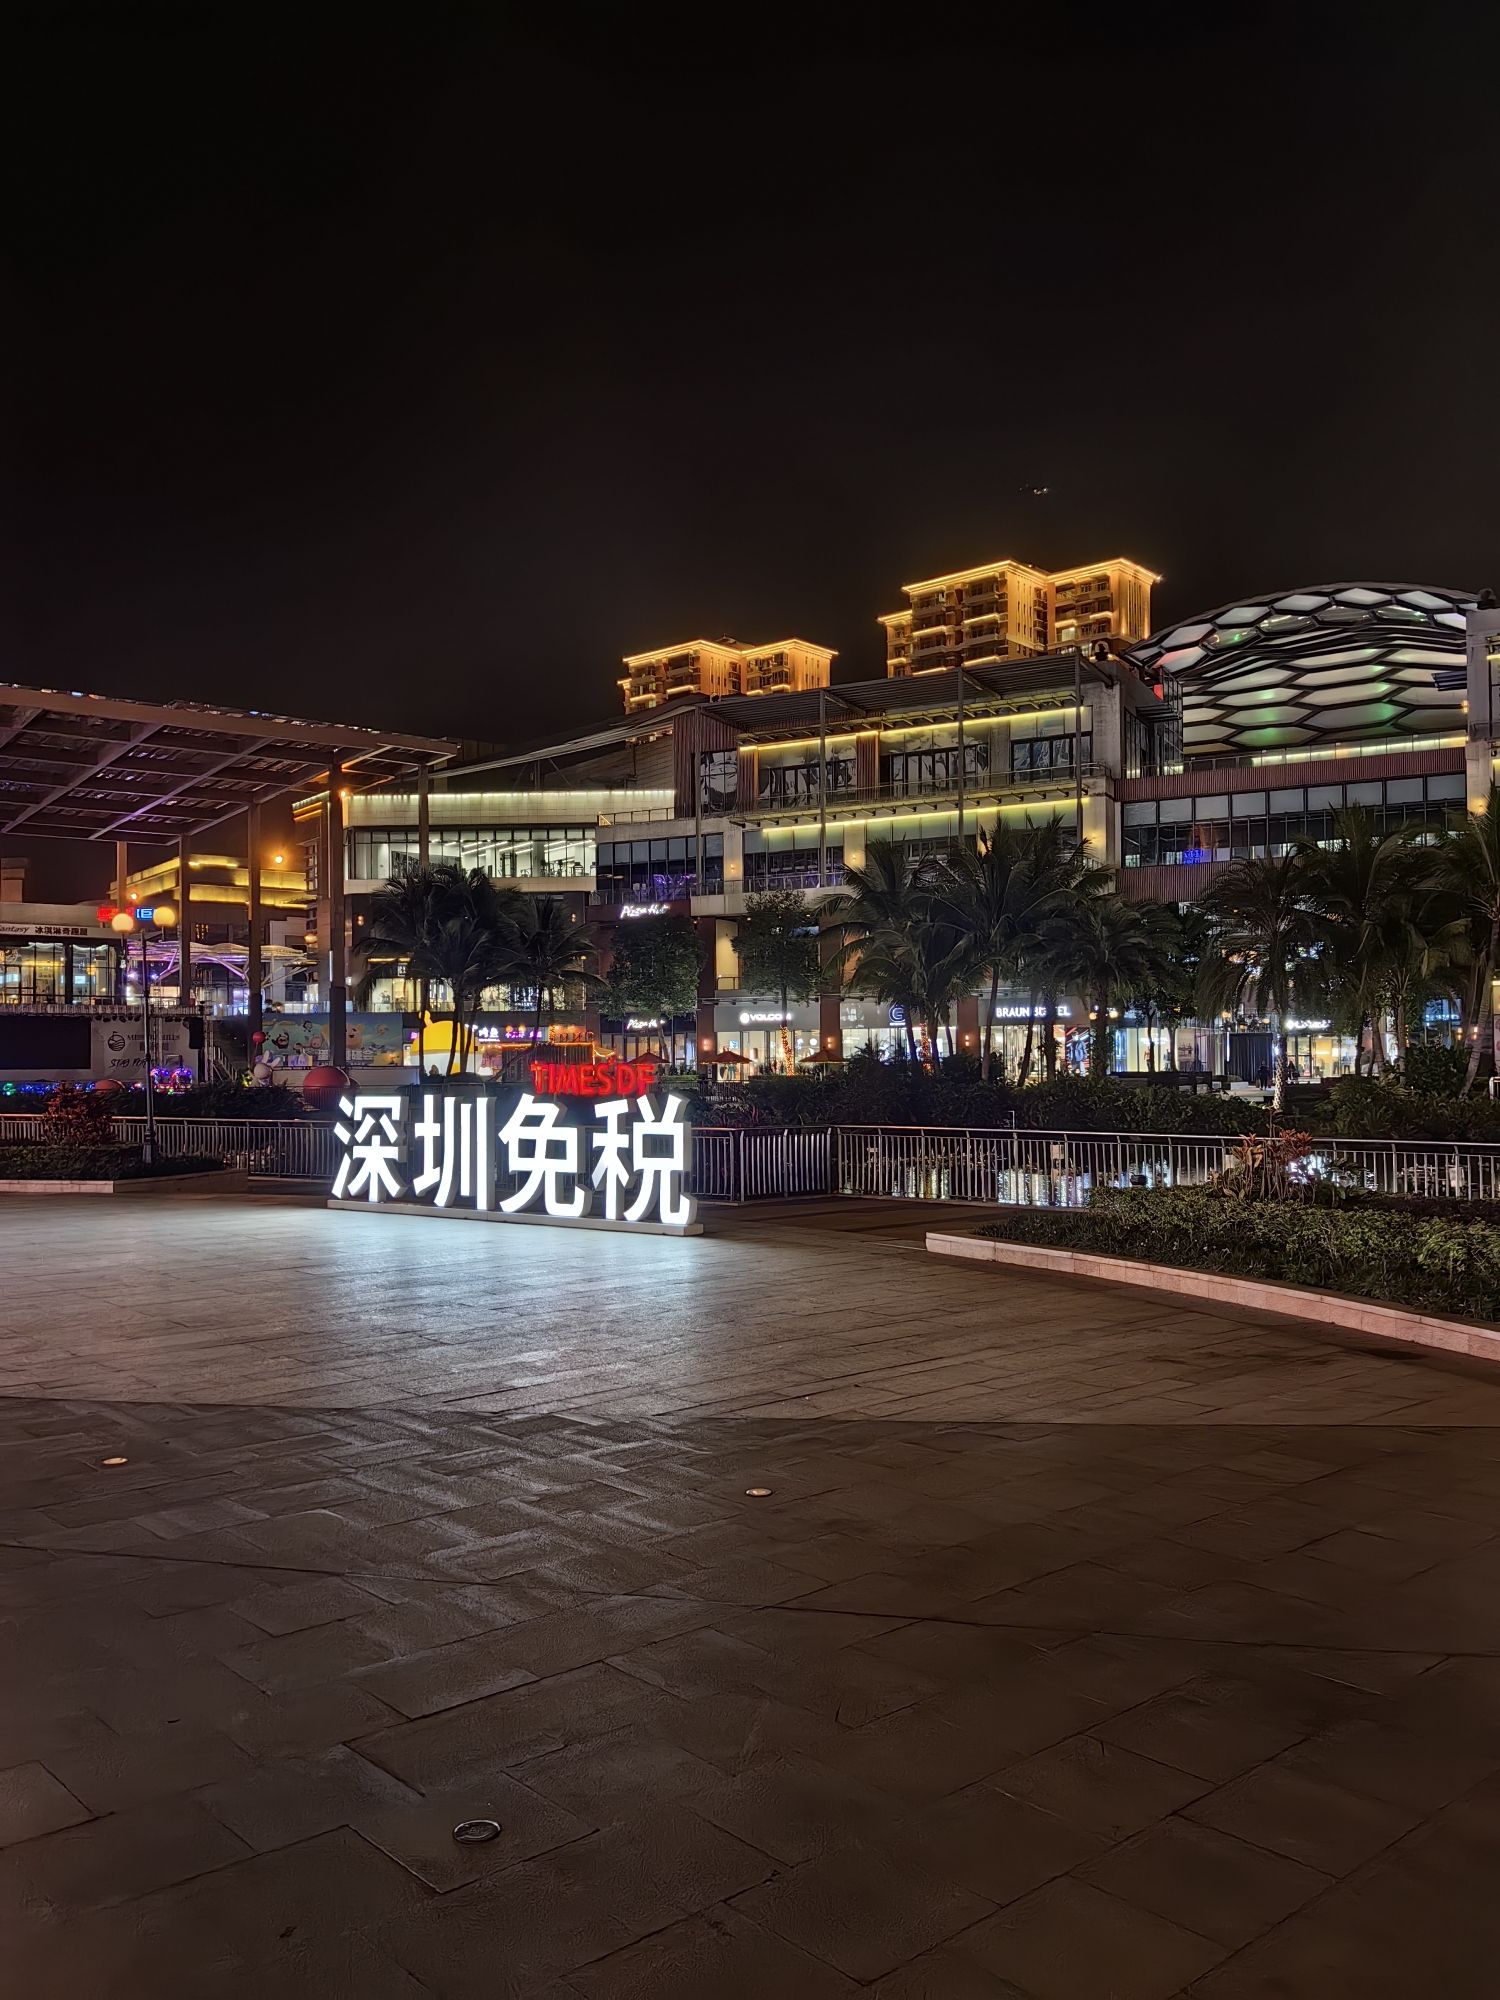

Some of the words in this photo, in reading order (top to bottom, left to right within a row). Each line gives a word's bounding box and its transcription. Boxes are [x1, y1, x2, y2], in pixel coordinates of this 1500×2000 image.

[620, 904, 649, 919] Pizza
[996, 1006, 1030, 1018] BRAUN
[626, 1018, 648, 1030] Pizza
[331, 1093, 696, 1226] 深圳免税
